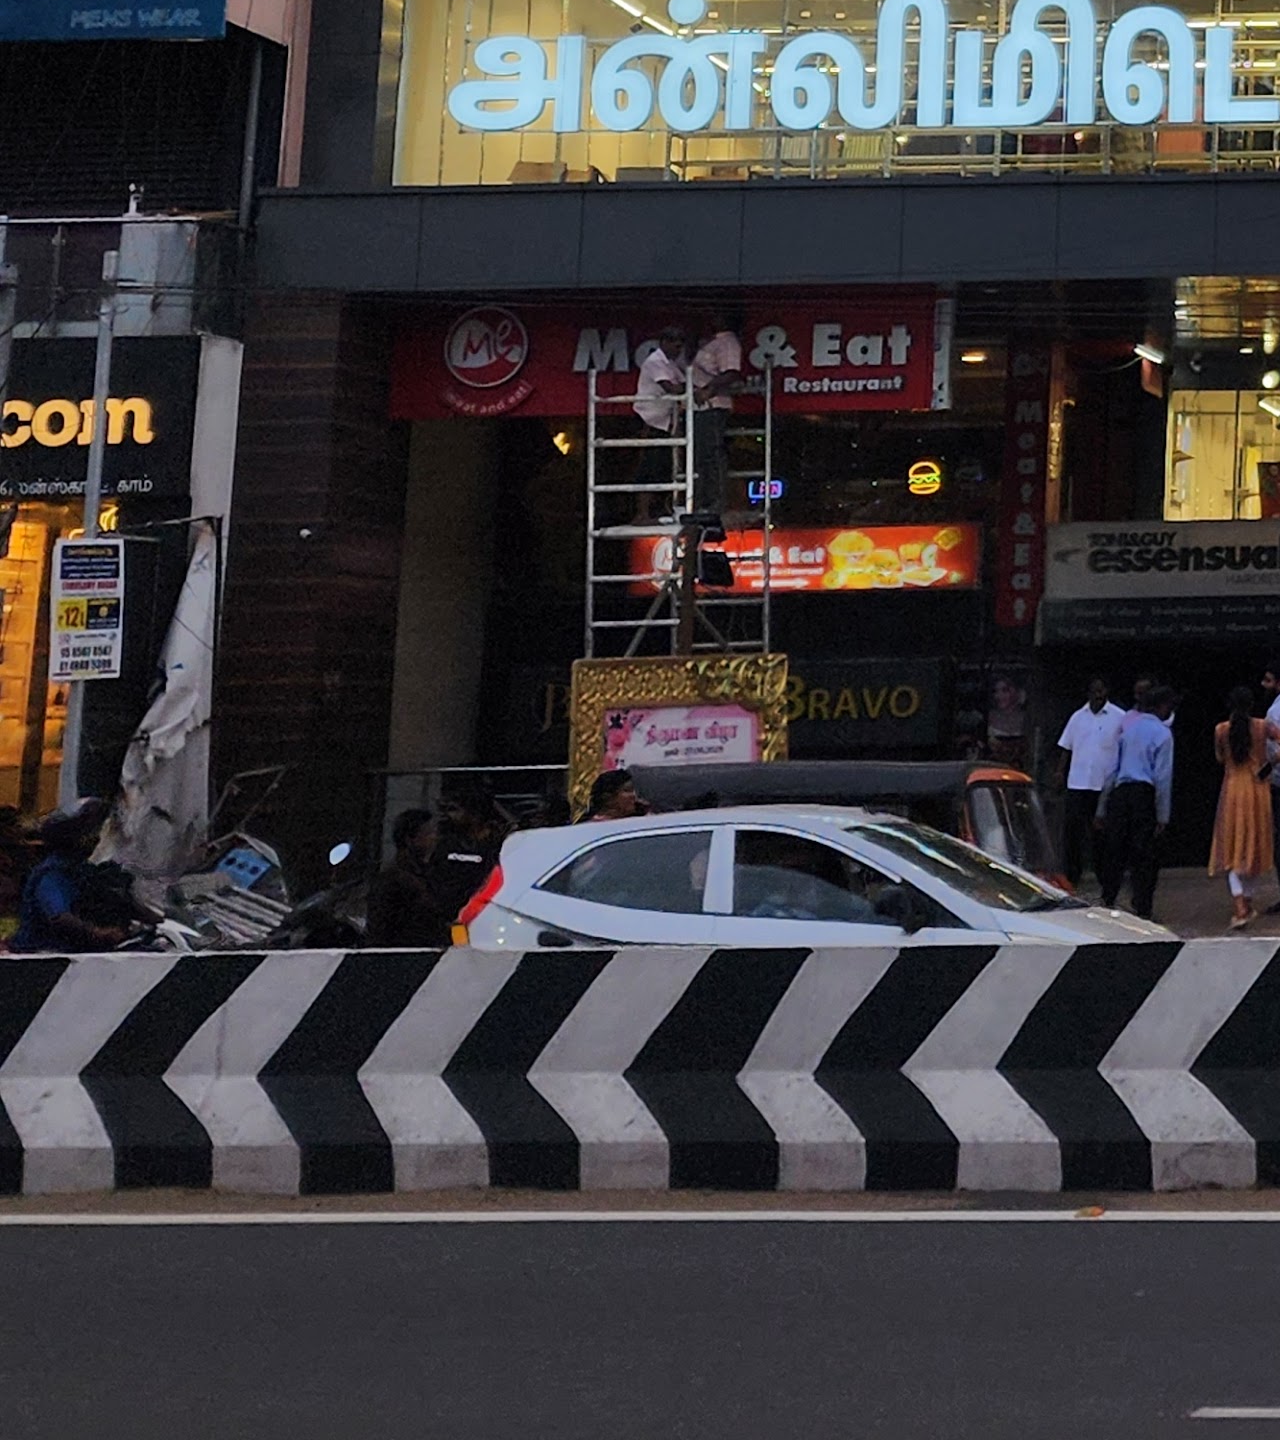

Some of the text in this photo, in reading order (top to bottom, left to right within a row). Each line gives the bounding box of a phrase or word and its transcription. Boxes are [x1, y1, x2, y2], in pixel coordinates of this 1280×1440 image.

[749, 323, 912, 368] & Eat
[784, 376, 904, 395] Restaurant
